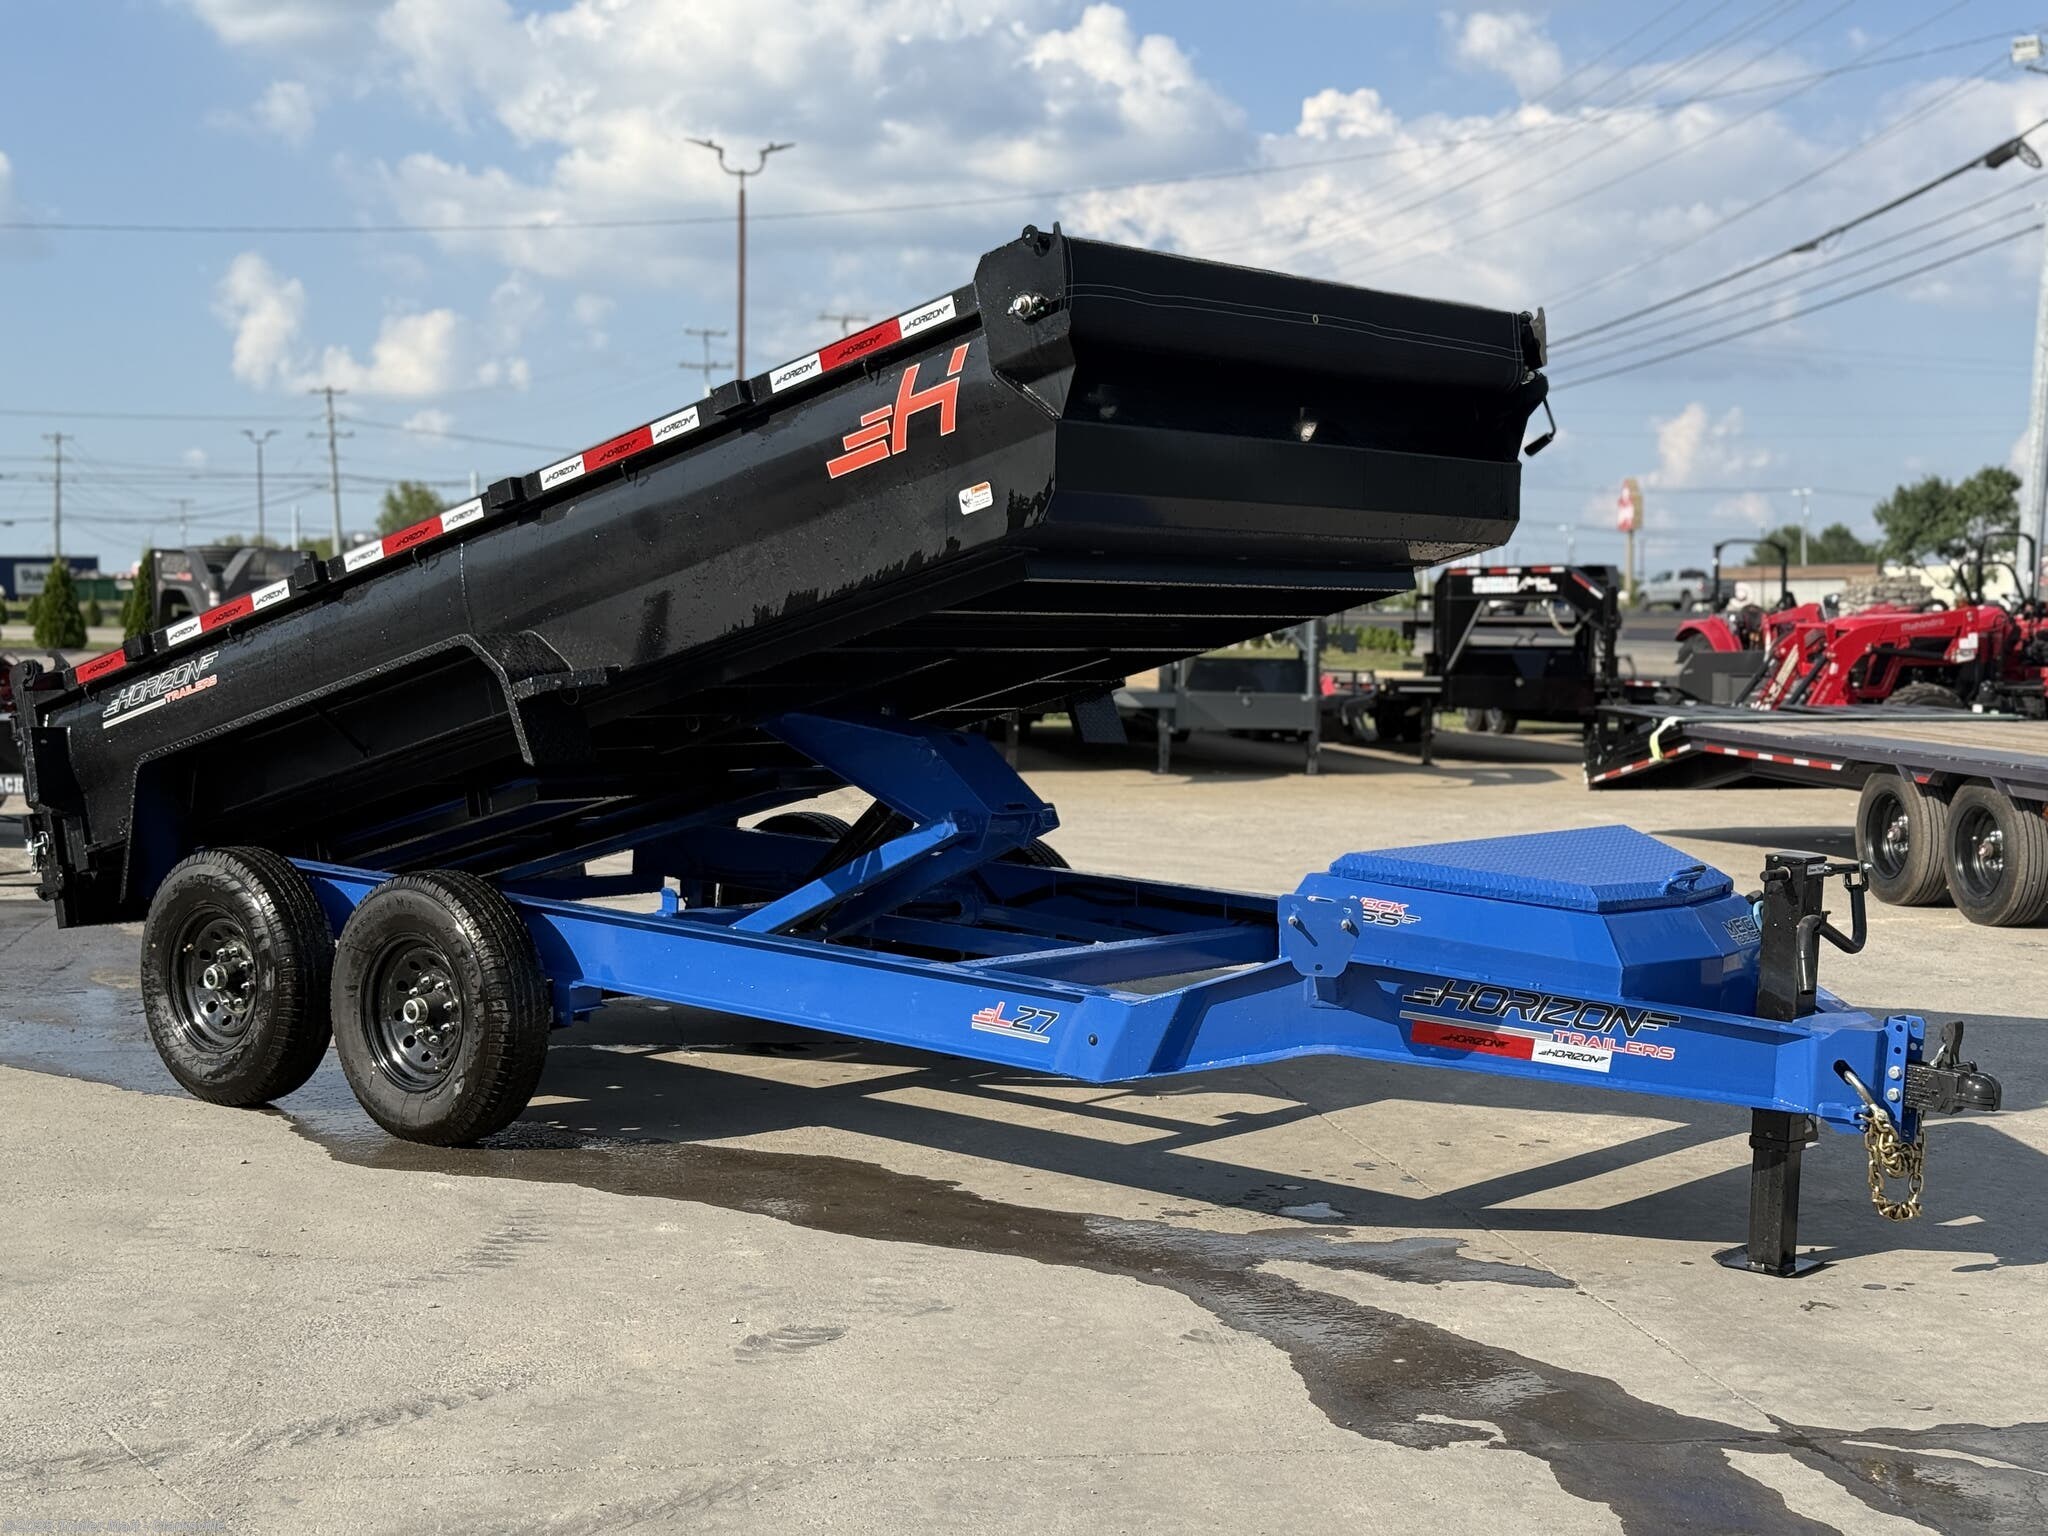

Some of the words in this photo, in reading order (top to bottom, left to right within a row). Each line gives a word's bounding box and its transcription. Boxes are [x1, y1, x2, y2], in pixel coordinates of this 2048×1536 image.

[903, 304, 950, 331] HORIZON
[837, 333, 882, 360] HORIZON
[774, 360, 818, 385] HORIZON
[655, 412, 695, 438] HORIZON
[599, 439, 638, 461] HORIZON
[545, 461, 581, 483] HORIZON
[445, 506, 480, 526] HORIZON
[396, 527, 429, 547] HORIZON
[255, 588, 286, 606] HORIZON
[102, 651, 219, 718] HORIZON
[164, 674, 218, 703] TRAILERS
[1721, 915, 1759, 937] MEG
[1403, 979, 1680, 1037] HORIZON
[1440, 1033, 1510, 1048] HORIZON
[1553, 1029, 1675, 1060] TRAILERS
[1538, 1048, 1609, 1064] HORIZON
